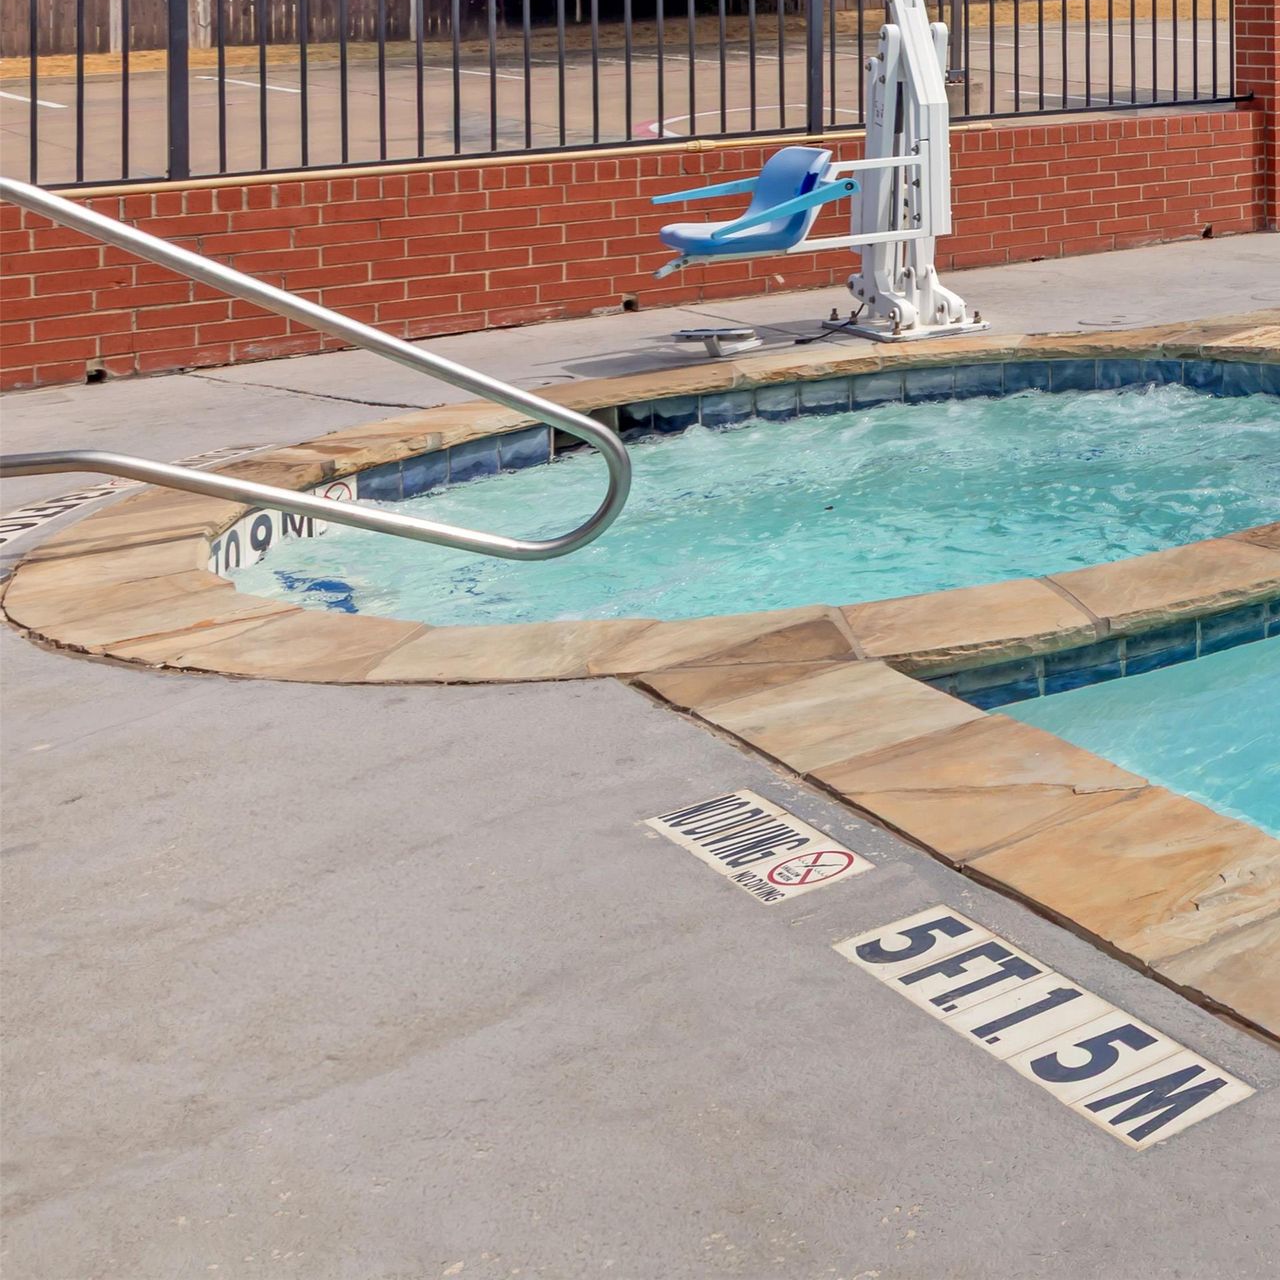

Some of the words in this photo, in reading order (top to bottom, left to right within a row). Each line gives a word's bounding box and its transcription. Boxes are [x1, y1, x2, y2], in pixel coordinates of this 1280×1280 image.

[658, 794, 751, 828] NO
[680, 807, 810, 868] DIVING
[730, 870, 757, 883] NO
[742, 878, 786, 902] DIVING
[855, 915, 974, 964] 5
[1084, 1064, 1228, 1142] M
